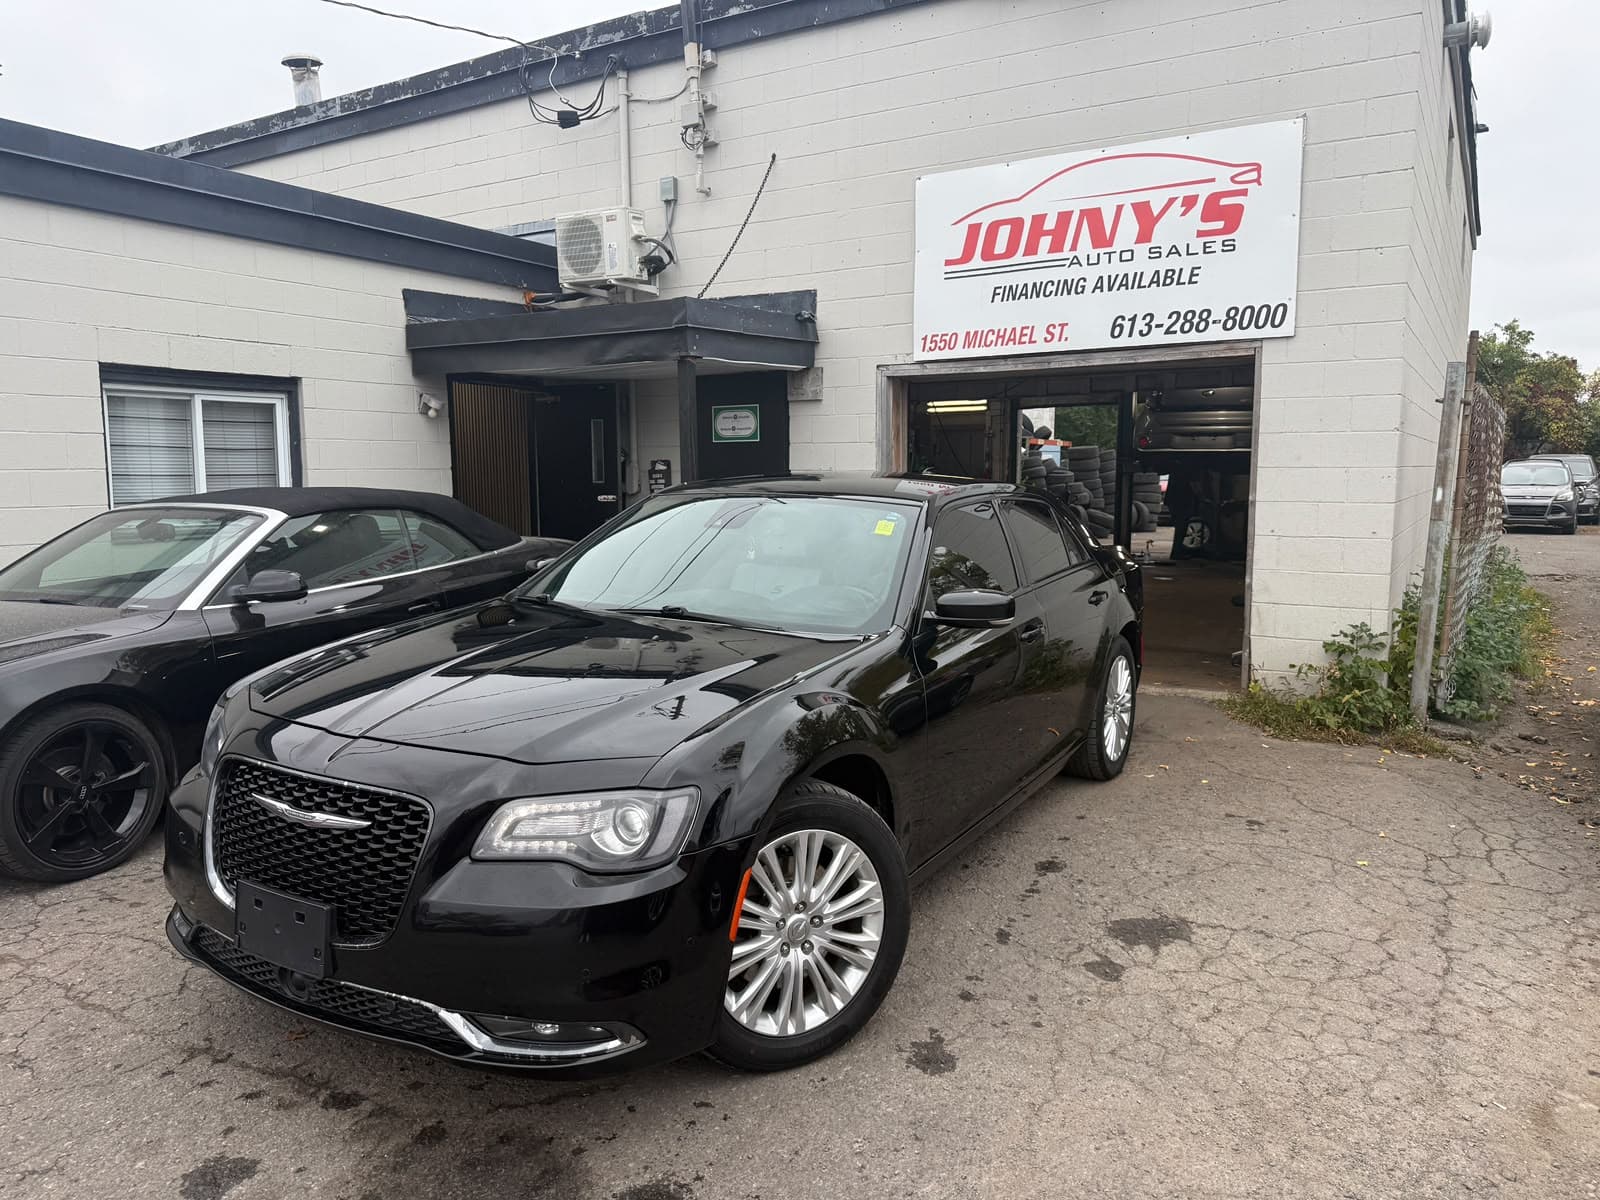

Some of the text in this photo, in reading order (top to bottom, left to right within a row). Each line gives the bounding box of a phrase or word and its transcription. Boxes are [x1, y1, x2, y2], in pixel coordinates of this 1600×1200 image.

[944, 188, 1248, 266] JOHNY'S
[1067, 239, 1236, 268] AUTO SALES
[991, 266, 1202, 304] FINANCING AVAILABLE
[920, 322, 1069, 352] 1550 MICHAEL ST.
[1110, 302, 1288, 339] 613-288-8000
